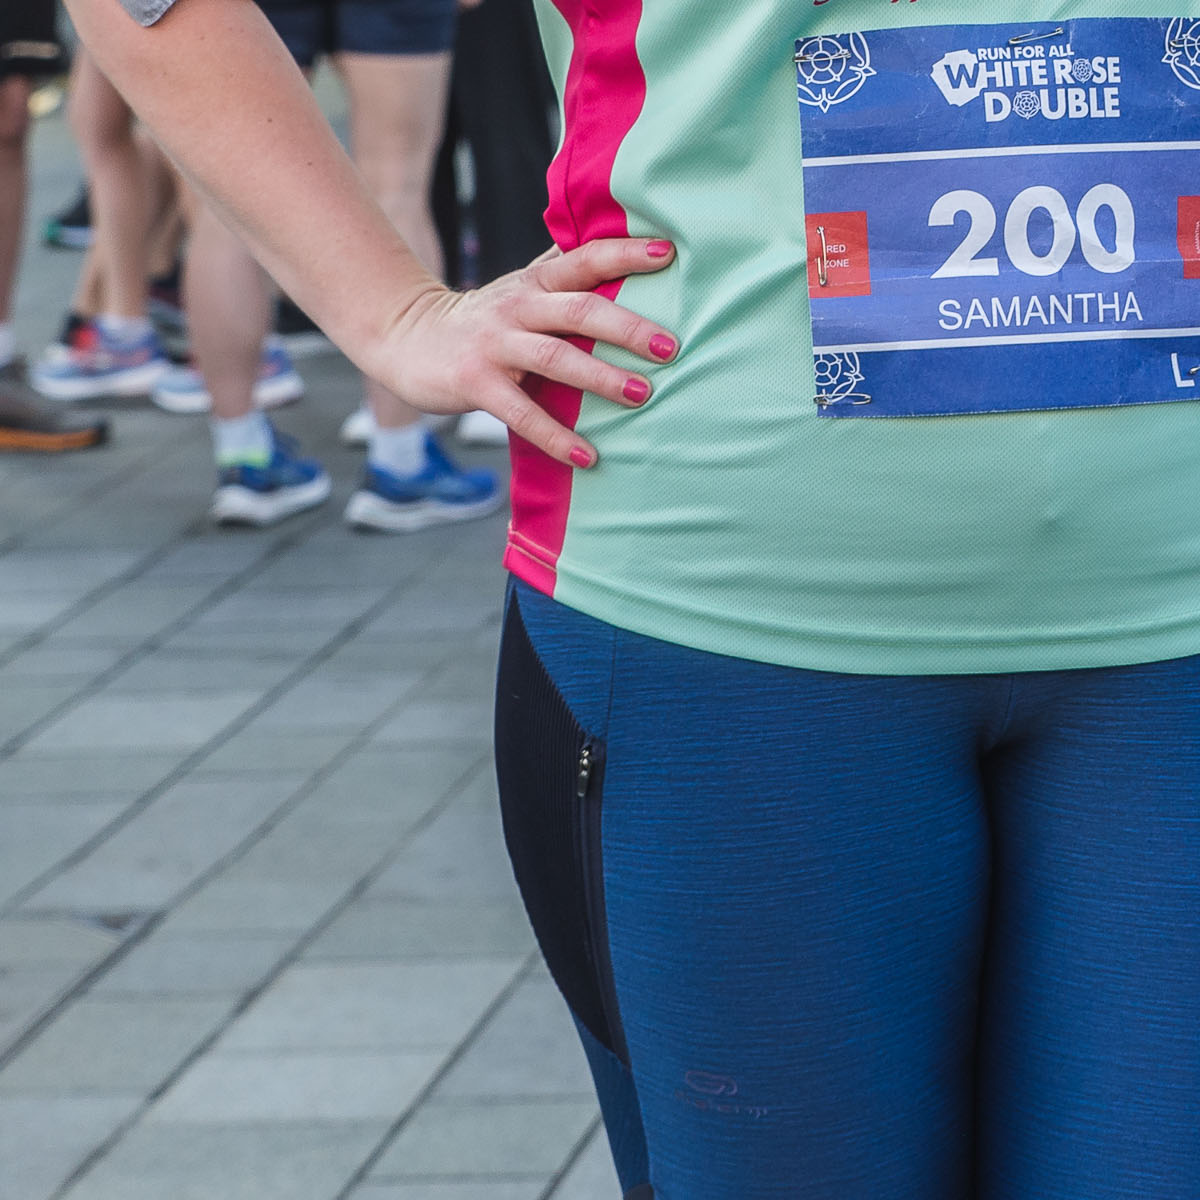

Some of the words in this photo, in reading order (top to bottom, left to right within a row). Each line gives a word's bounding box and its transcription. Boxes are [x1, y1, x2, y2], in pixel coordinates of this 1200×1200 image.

[977, 48, 1011, 61] RUN
[1014, 45, 1045, 59] FOR
[1048, 43, 1075, 58] ALL
[943, 59, 1049, 90] WHITE
[983, 87, 1121, 123] DOUBLE
[927, 183, 1136, 280] 200
[825, 259, 850, 268] ZONE
[826, 244, 846, 253] RED
[937, 291, 1144, 331] SAMANTHA
[1170, 352, 1196, 388] L
